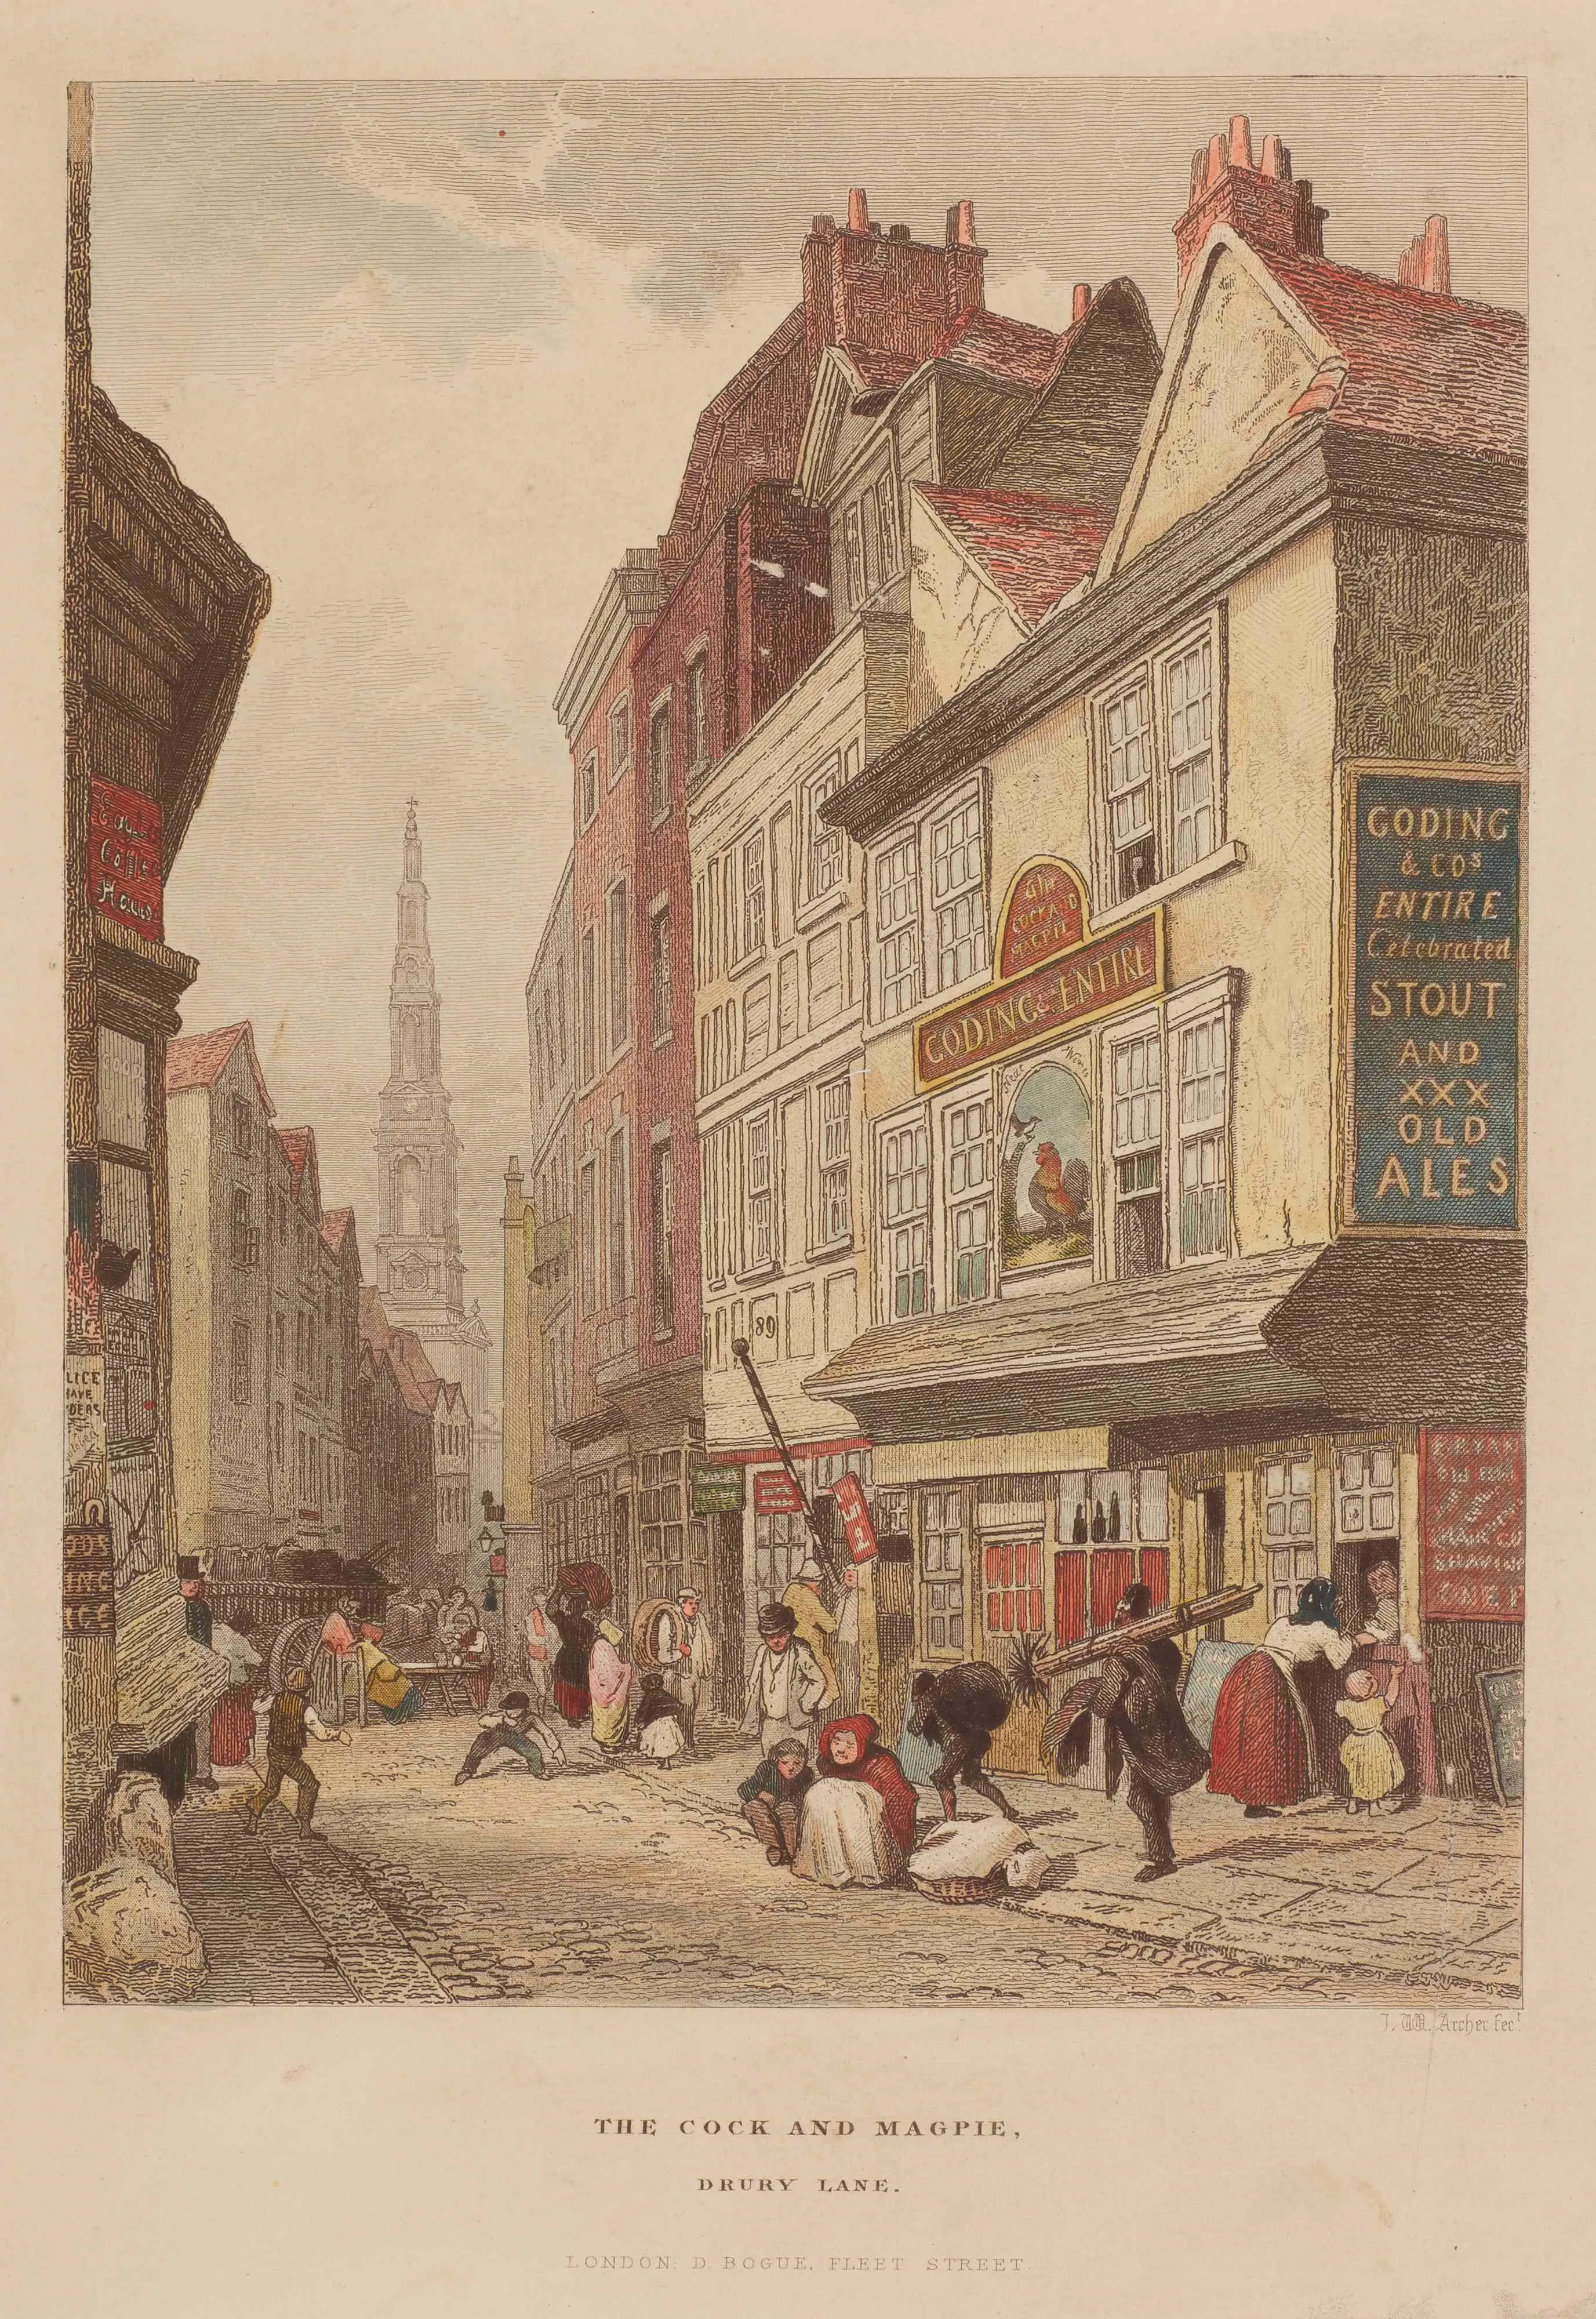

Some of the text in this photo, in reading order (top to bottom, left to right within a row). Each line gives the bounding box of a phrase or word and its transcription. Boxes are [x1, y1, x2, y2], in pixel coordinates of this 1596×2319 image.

[1367, 805, 1508, 841] GODING
[1401, 850, 1420, 877] &
[1374, 890, 1502, 921] ENTIRE
[1367, 929, 1511, 960] Celebrated
[926, 992, 1038, 1064] GODING
[1053, 945, 1153, 1014] ENTIRE
[1370, 979, 1506, 1020] STOUT
[1398, 1038, 1482, 1067] AND
[1401, 1077, 1490, 1108] XXX
[1398, 1113, 1487, 1147] OLD
[1376, 1152, 1510, 1200] ALES
[755, 1315, 776, 1339] 89
[1436, 2012, 1489, 2037] Archer
[594, 2118, 1020, 2140] THE COCK AND MAGPIE,
[696, 2178, 900, 2193] DRURY LANE.
[691, 2256, 712, 2270] D.
[828, 2257, 904, 2271] FLEET
